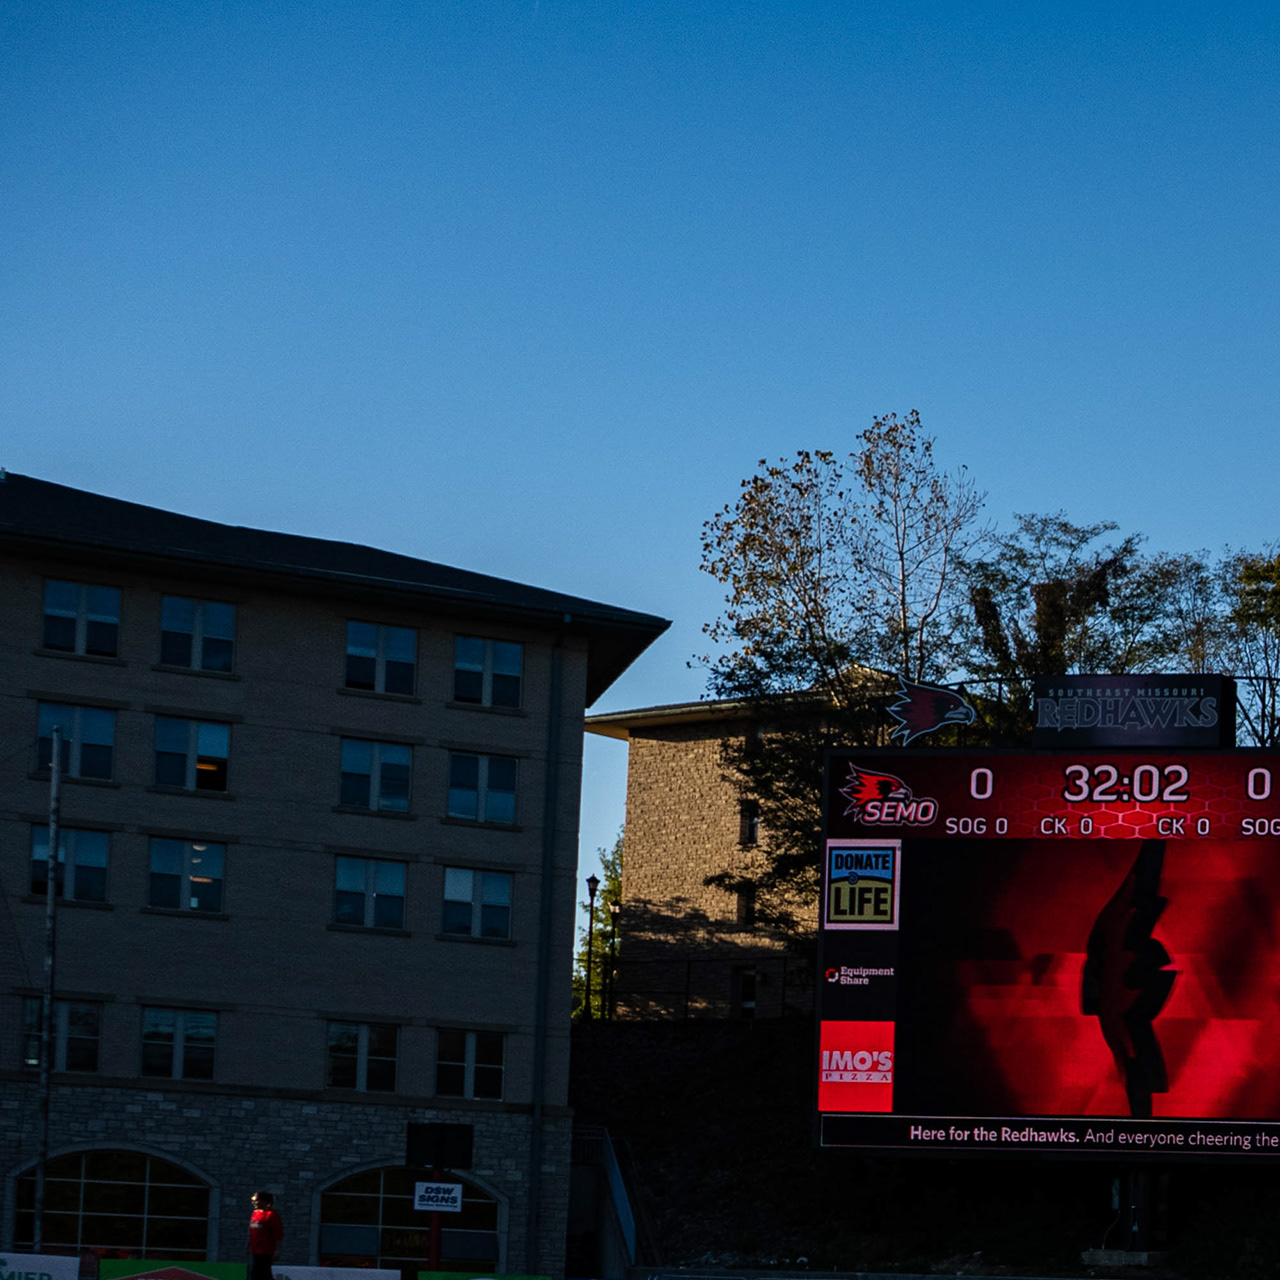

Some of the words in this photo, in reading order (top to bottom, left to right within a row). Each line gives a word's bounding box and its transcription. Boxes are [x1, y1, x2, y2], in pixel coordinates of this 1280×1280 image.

[1049, 687, 1130, 698] SOUTHEAST
[1136, 687, 1205, 697] MISSOURI
[1036, 697, 1219, 732] REDHAWKS
[970, 767, 994, 800] 0
[1063, 764, 1190, 802] 32:02
[1247, 767, 1271, 801] 0
[863, 801, 936, 823] SEMO
[946, 818, 987, 835] SOG
[995, 818, 1009, 835] 0
[1040, 818, 1068, 835] CK
[1080, 818, 1094, 835] 0
[1158, 819, 1186, 836] CK
[1197, 819, 1211, 836] 0
[834, 853, 890, 871] DONATE
[834, 886, 888, 916] LIFE
[841, 966, 895, 977] Equipment
[841, 976, 870, 985] Share
[822, 1050, 893, 1071] IMO'S
[825, 1073, 890, 1081] PIZZA
[910, 1126, 946, 1142] Here
[949, 1126, 972, 1142] for
[973, 1127, 998, 1143] the
[1001, 1127, 1080, 1143] Redhawks.
[1084, 1129, 1115, 1144] And
[1118, 1132, 1185, 1147] everyone
[1188, 1130, 1252, 1148] cheering
[418, 1194, 458, 1204] SIGNS
[425, 1186, 455, 1195] DSW
